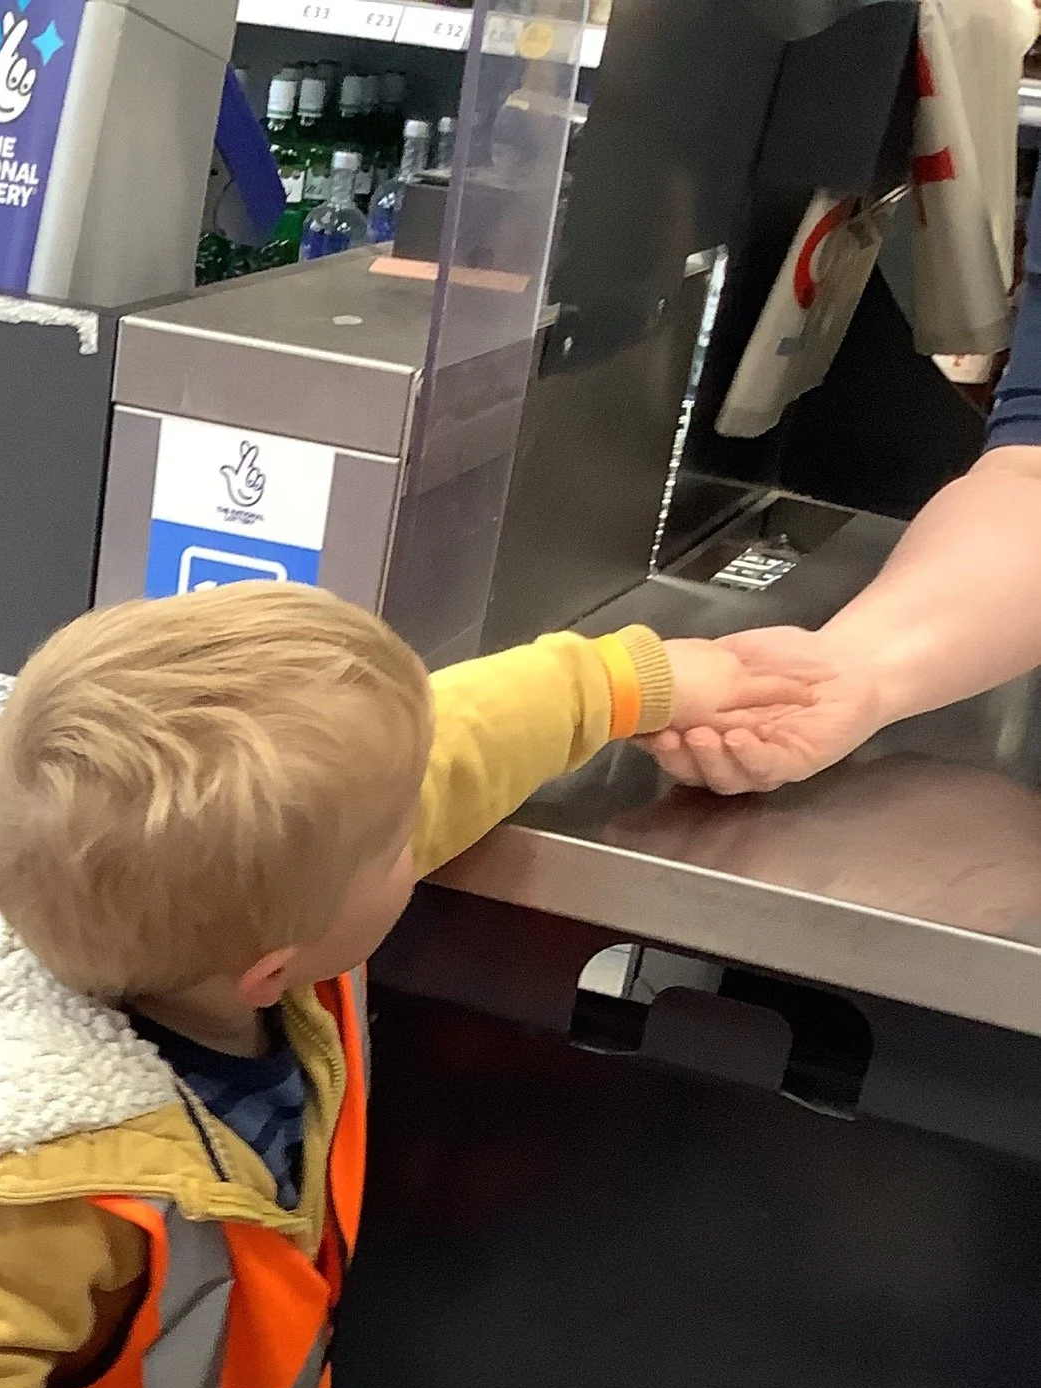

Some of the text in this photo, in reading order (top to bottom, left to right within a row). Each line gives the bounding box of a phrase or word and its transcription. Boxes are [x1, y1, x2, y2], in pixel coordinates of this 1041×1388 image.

[302, 5, 394, 27] £33 £23
[433, 22, 464, 38] £32
